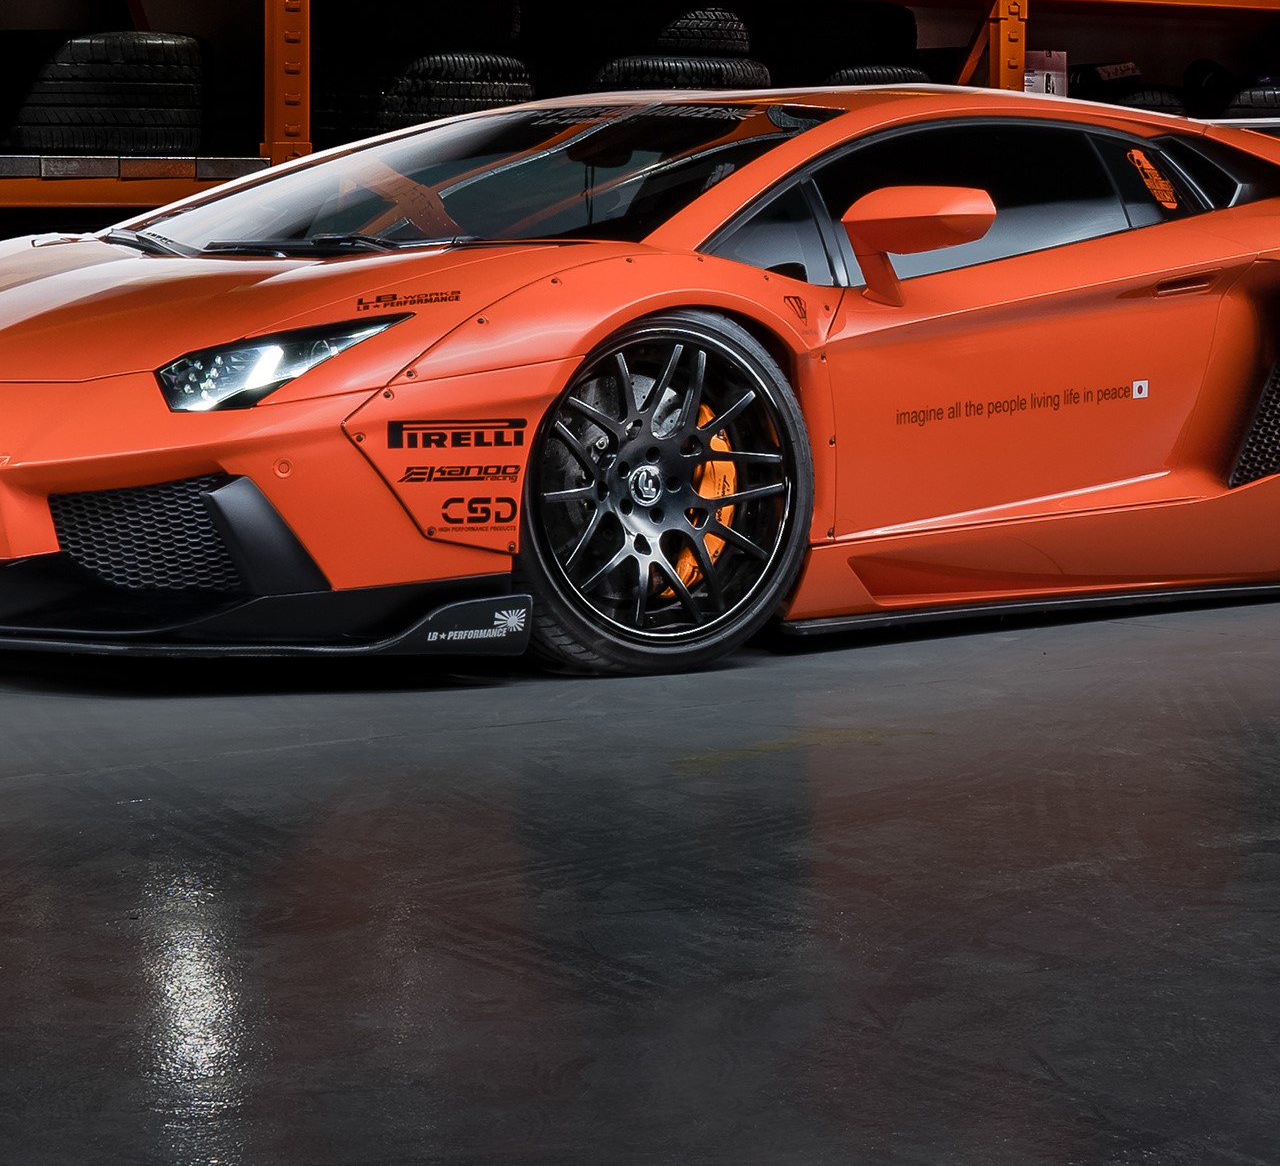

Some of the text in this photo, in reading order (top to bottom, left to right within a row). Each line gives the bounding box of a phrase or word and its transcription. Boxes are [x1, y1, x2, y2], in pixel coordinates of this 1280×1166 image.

[383, 295, 460, 308] PERFORMANCE
[895, 384, 1131, 427] imagine all the people living life in peace
[387, 418, 528, 449] PIRELLI
[484, 475, 518, 483] racing
[441, 497, 517, 524] CSD
[427, 627, 508, 641] LB PERFORMANCE
